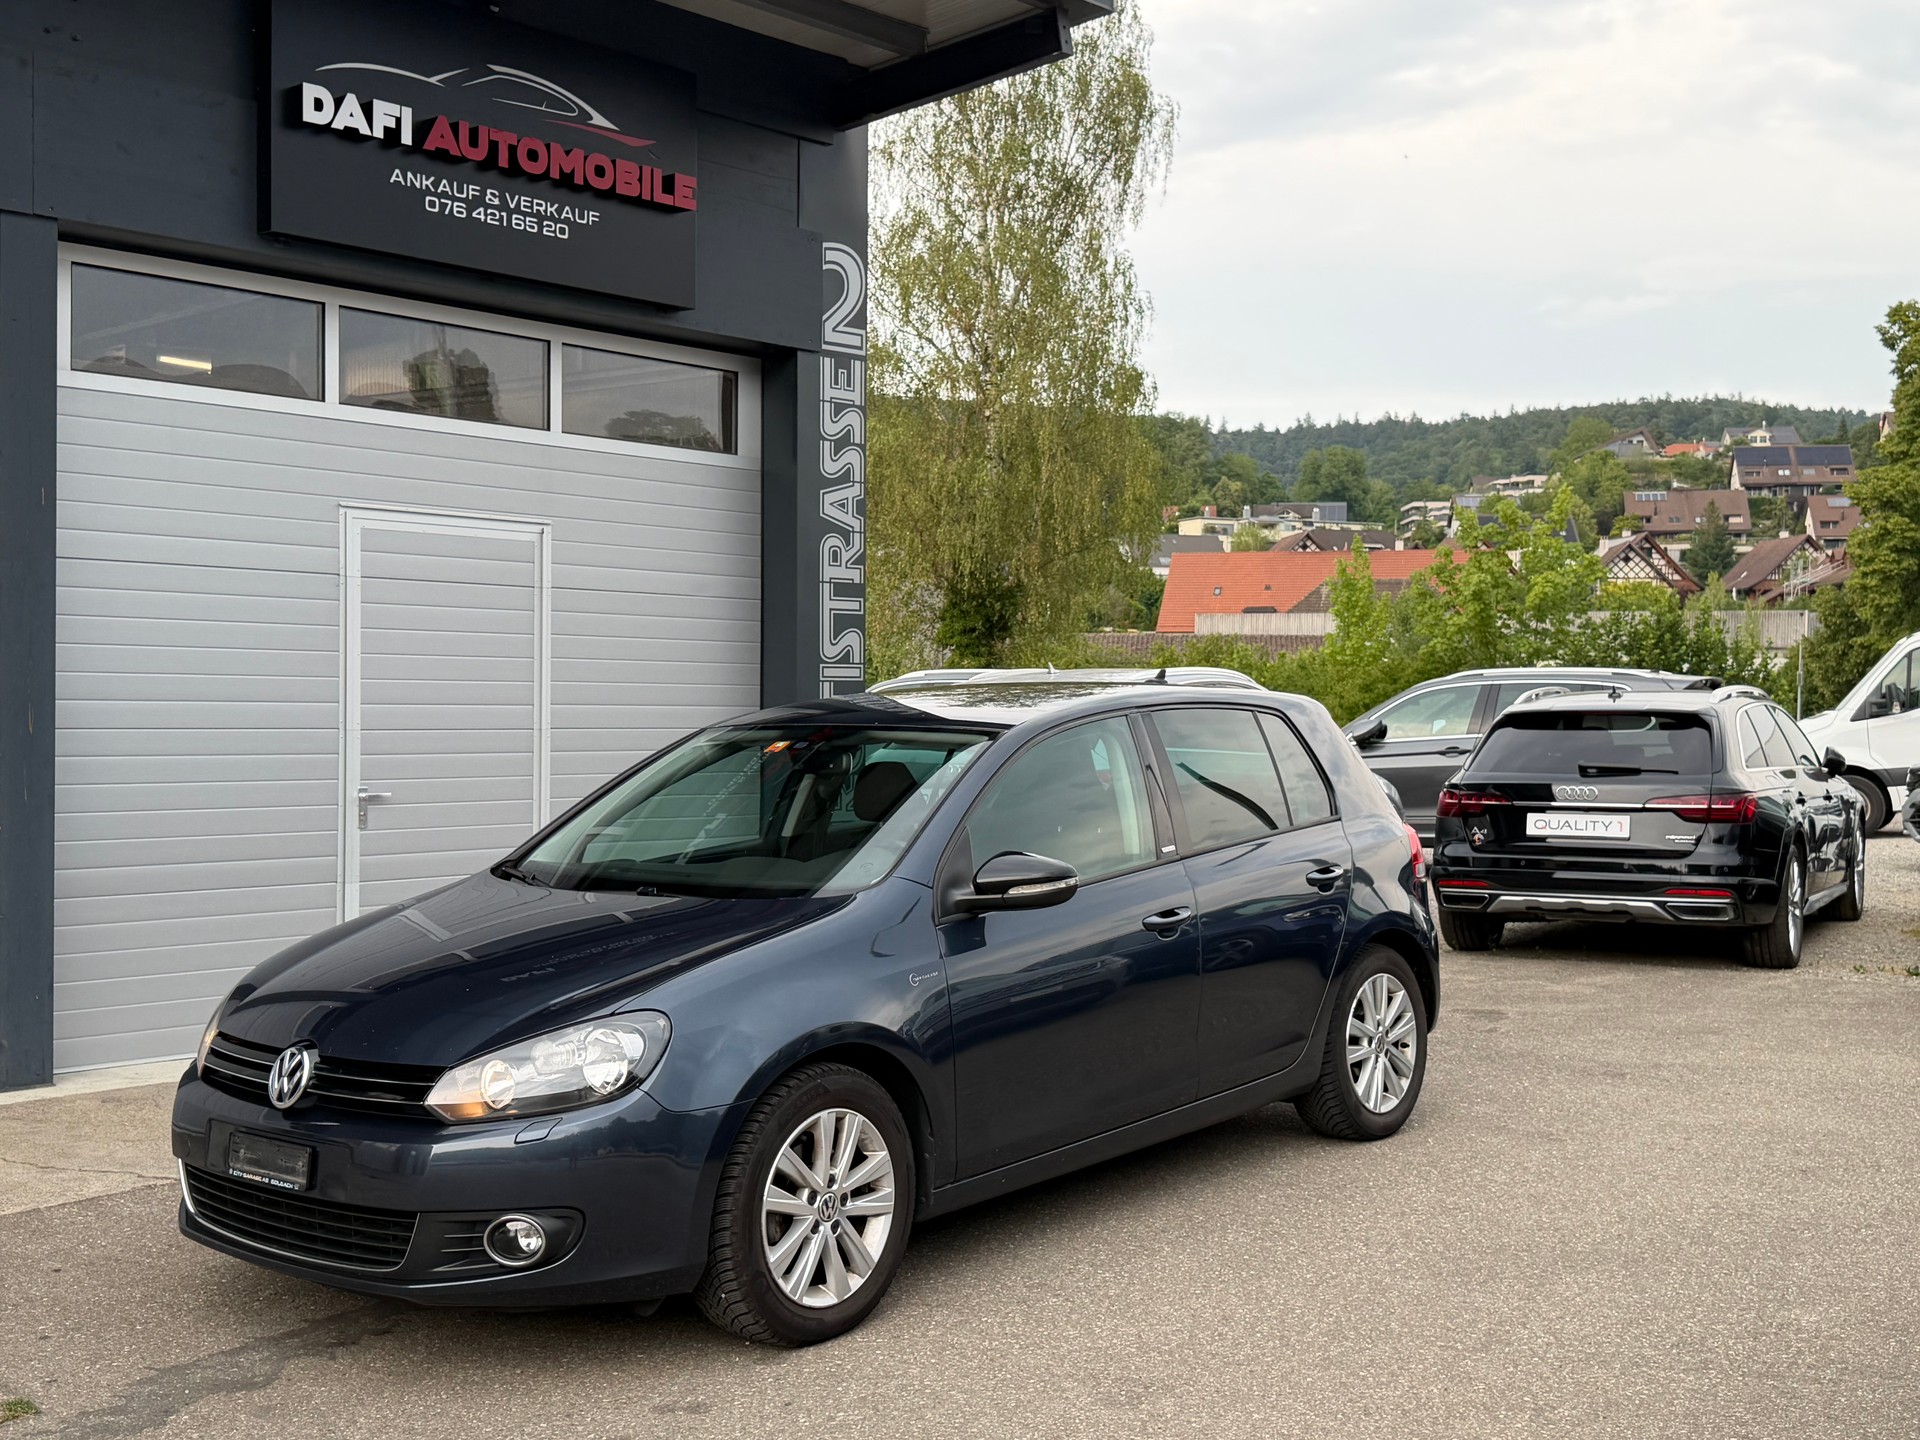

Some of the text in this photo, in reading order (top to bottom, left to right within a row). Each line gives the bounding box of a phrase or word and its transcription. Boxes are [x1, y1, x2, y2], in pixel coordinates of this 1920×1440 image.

[303, 82, 698, 212] DAFI AUTOMOBILE
[389, 168, 600, 226] ANKAUF & VERKAUF
[424, 195, 569, 240] 076 421 65 20
[820, 241, 866, 357] 2
[1533, 818, 1623, 833] QUALITY 1
